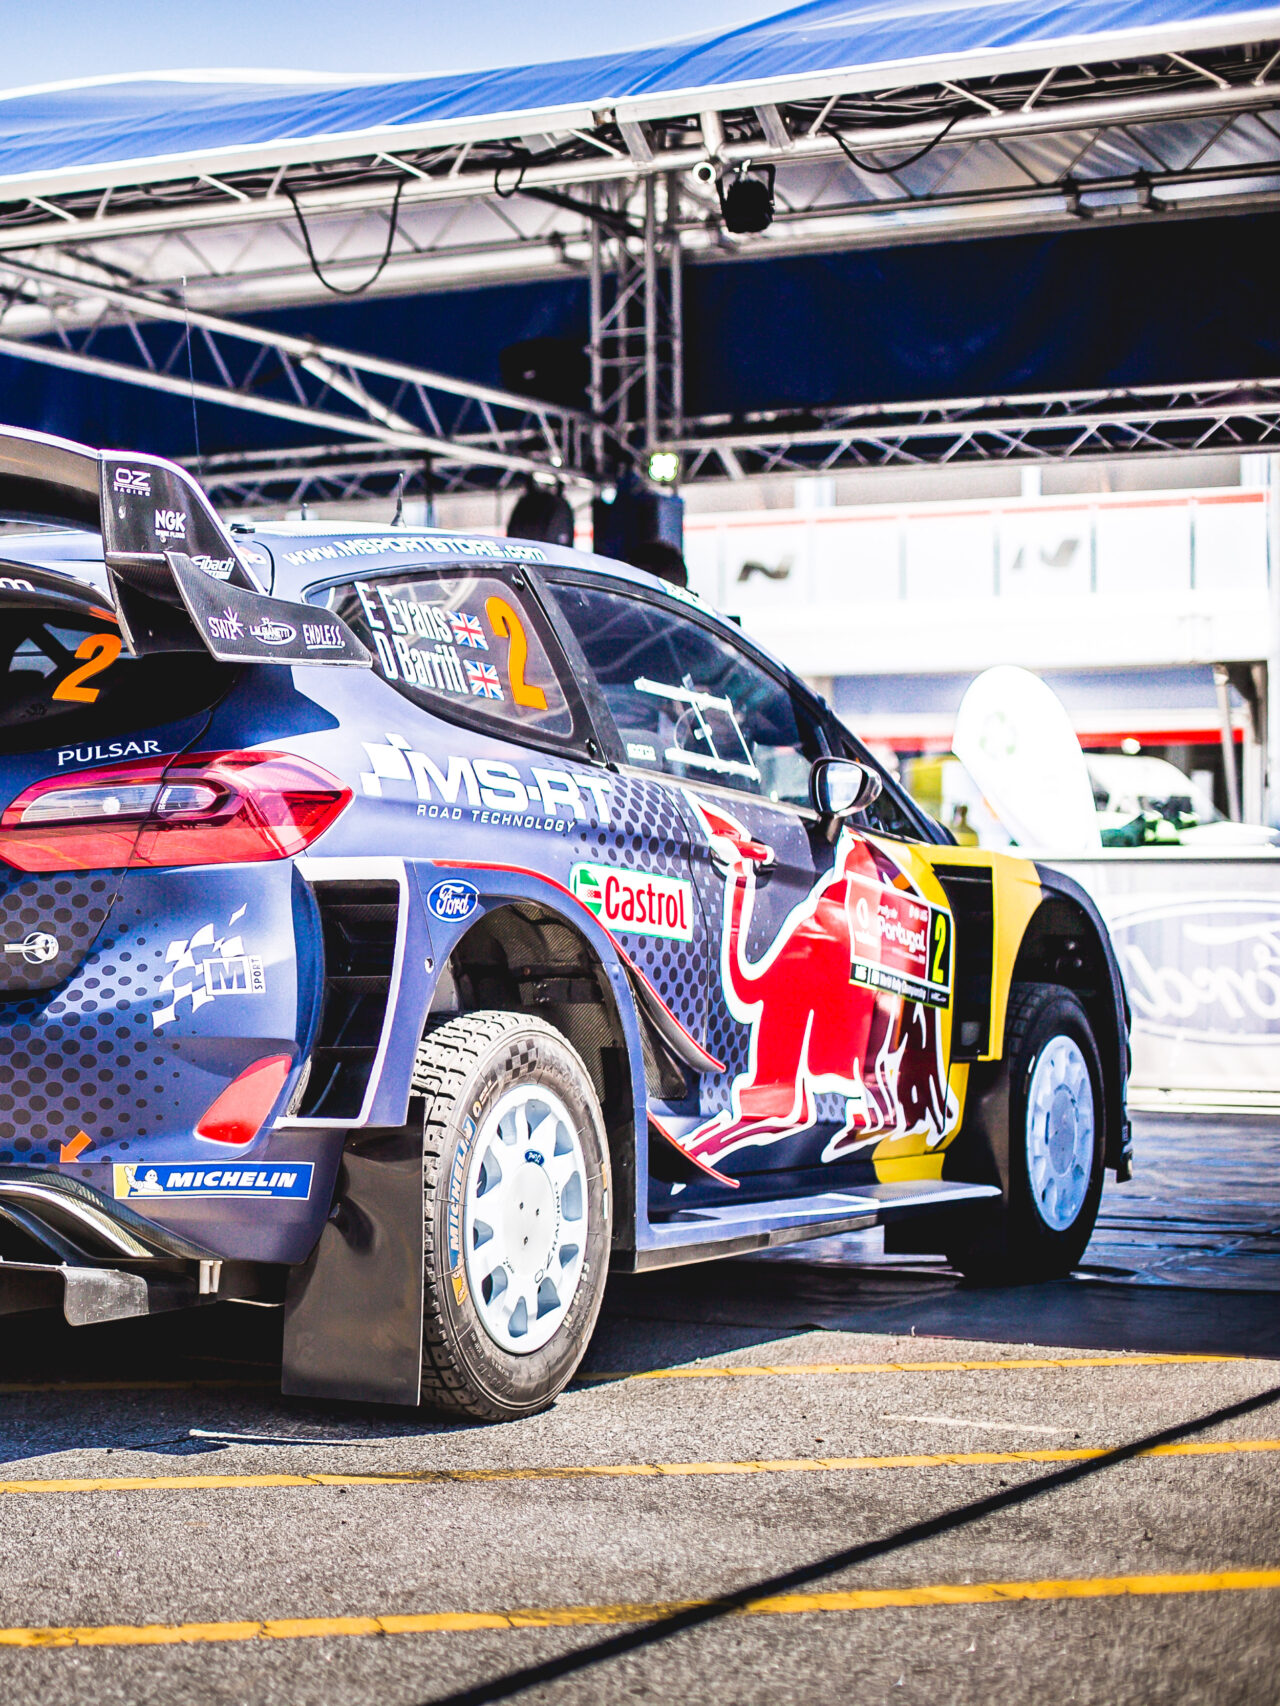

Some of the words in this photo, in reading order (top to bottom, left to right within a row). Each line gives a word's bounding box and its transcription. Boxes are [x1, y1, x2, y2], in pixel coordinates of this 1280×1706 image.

[155, 509, 187, 533] NGK
[354, 581, 385, 630] E
[376, 585, 455, 643] Evans
[52, 633, 122, 703] 2
[372, 630, 399, 681] D
[391, 634, 469, 695] Barritt
[485, 596, 549, 711] 2
[57, 740, 162, 766] PULSAR
[417, 804, 462, 821] ROAD
[471, 809, 576, 833] TECHNOLOGY
[436, 884, 470, 915] Ford
[605, 875, 688, 930] Castrol
[251, 958, 264, 990] SPORT
[932, 913, 947, 984] 2
[166, 1170, 298, 1189] MICHELIN
[449, 1122, 475, 1252] MICHELIN
